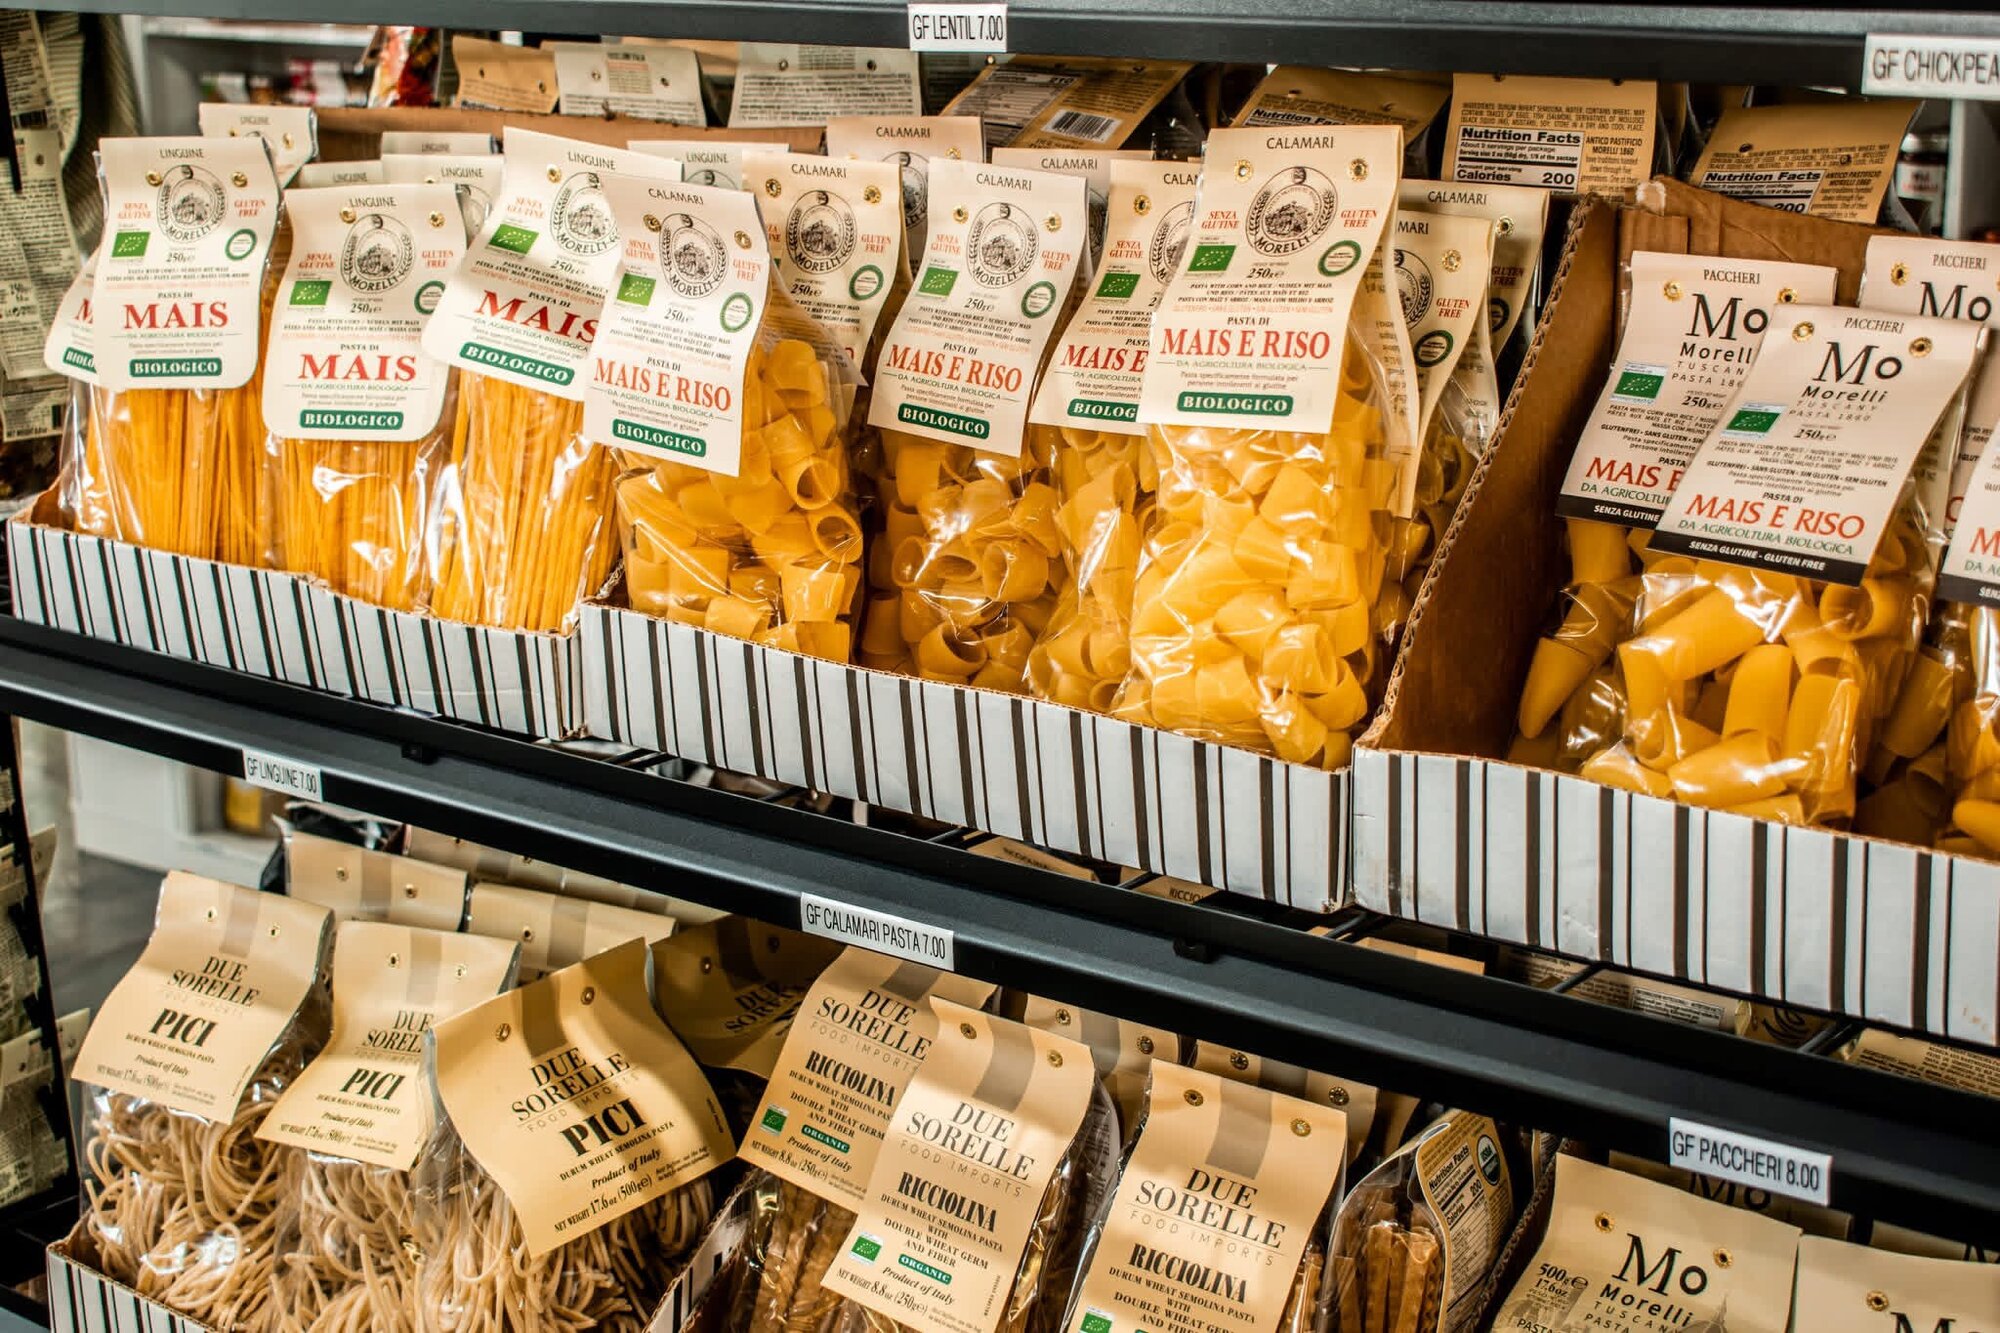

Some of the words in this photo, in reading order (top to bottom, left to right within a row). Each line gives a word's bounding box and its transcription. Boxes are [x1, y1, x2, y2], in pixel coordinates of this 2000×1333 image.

[913, 15, 929, 39] GF
[933, 15, 975, 40] LENTIL
[978, 15, 1004, 40] 7.00
[1873, 49, 1899, 80] GF
[1904, 50, 1999, 84] CHICKPEA
[876, 126, 931, 138] CALAMARI
[1266, 136, 1334, 150] CALAMARI
[1462, 127, 1531, 142] Nutrition
[1537, 131, 1581, 144] Facts
[160, 148, 204, 159] LINGUINE
[568, 152, 616, 170] LINGUINE
[1041, 157, 1098, 170] CALAMARI
[441, 167, 484, 178] LINGUINE
[791, 164, 847, 179] CALAMARI
[976, 173, 1032, 191] CALAMARI
[1457, 169, 1511, 182] Calories
[1542, 172, 1575, 185] 200
[1706, 171, 1775, 184] Nutrition
[1778, 171, 1820, 182] Facts
[350, 197, 397, 208] LINGUINE
[648, 188, 704, 205] CALAMARI
[1428, 191, 1488, 205] CALAMARI
[1202, 220, 1239, 229] GLUTINE
[1209, 211, 1238, 220] SENZA
[1340, 210, 1378, 219] GLUTEN
[1344, 219, 1369, 228] FREE
[861, 234, 892, 245] GLUTEN
[866, 244, 886, 254] FREE
[1116, 240, 1142, 250] SENZA
[1042, 250, 1071, 262] GLUTEN
[1044, 260, 1064, 271] FREE
[1110, 250, 1144, 259] GLUTINE
[1933, 254, 1986, 270] PACCHERI
[1703, 269, 1760, 285] PACCHERI
[528, 291, 554, 304] PASTA
[556, 298, 571, 308] DI
[1436, 298, 1469, 309] GLUTEN
[123, 302, 228, 330] MAIS
[474, 290, 599, 343] MAIS
[1227, 317, 1256, 326] PASTA
[1258, 317, 1270, 326] DI
[1438, 308, 1462, 318] FREE
[1684, 294, 1768, 341] Mo
[1844, 317, 1905, 334] PACCHERI
[943, 342, 967, 353] PASTA
[968, 346, 978, 355] DI
[1160, 328, 1232, 356] MAIS
[1237, 330, 1256, 356] E
[1263, 331, 1331, 359] RISO
[1679, 342, 1753, 365] Morell
[134, 360, 220, 375] BIOLOGICO
[298, 354, 417, 381] MAIS
[464, 345, 570, 383] BIOLOGICO
[646, 356, 672, 369] PASTA
[672, 362, 681, 371] DI
[886, 344, 946, 377] MAIS
[946, 356, 966, 381] E
[968, 360, 1023, 393] RISO
[1061, 345, 1131, 370] MAIS
[1812, 342, 1903, 386] Mo
[594, 358, 656, 393] MAIS
[656, 373, 670, 398] E
[675, 376, 732, 411] RISO
[1802, 386, 1888, 403] Morelli
[1073, 402, 1138, 418] BIOLOG
[1183, 396, 1288, 412] BIOLOGICO
[304, 413, 400, 427] BIOLOGICO
[902, 407, 986, 436] BIOLOGICO
[616, 423, 703, 453] BIOLOGICO
[1586, 456, 1661, 488] MAIS
[1658, 457, 1687, 467] PASTA
[1762, 492, 1791, 502] PASTA
[1594, 505, 1621, 517] SENZA
[1623, 509, 1660, 523] GLUTINE
[1684, 494, 1765, 525] MAIS
[1769, 503, 1789, 528] E
[1796, 509, 1866, 539] RISO
[1678, 519, 1697, 531] DA
[1701, 523, 1781, 544] AGRICOLTURA
[1785, 535, 1853, 555] BIOLOGICA
[1689, 542, 1716, 553] SENZA
[1718, 544, 1756, 559] GLUTINE
[1764, 553, 1799, 566] GLUTEN
[1801, 560, 1826, 571] FREE
[806, 904, 821, 925] GF
[824, 908, 880, 942] CALAMARI
[883, 924, 920, 953] PASTA
[923, 934, 946, 960] 7.00
[202, 956, 248, 983] DUE
[167, 970, 260, 1009] SORELLE
[858, 989, 917, 1027] DUE
[148, 1008, 219, 1048] PICI
[394, 1010, 434, 1033] DUE
[816, 996, 933, 1062] SORELLE
[530, 1047, 588, 1088] DUE
[805, 1050, 897, 1108] RICCIOLINA
[340, 1068, 406, 1101] PICI
[512, 1052, 632, 1122] SORELLE
[790, 1090, 825, 1114] DOUBLE
[827, 1107, 859, 1129] WHEAT
[860, 1123, 886, 1140] GERM
[830, 1099, 849, 1113] WITH
[559, 1098, 648, 1158] PICI
[808, 1111, 828, 1126] AND
[829, 1119, 855, 1139] FIBER
[952, 1102, 1015, 1143] DUE
[560, 1164, 587, 1181] DURUM
[588, 1152, 614, 1169] WHEAT
[614, 1132, 652, 1155] SEMOLINA
[651, 1121, 675, 1137] PASTA
[803, 1127, 849, 1151] ORGANIC
[906, 1112, 1037, 1182] SORELLE
[592, 1166, 627, 1190] Product
[628, 1158, 639, 1174] of
[638, 1148, 662, 1169] Italy
[901, 1140, 943, 1167] FOOD
[951, 1161, 1023, 1198] IMPORTS
[1673, 1131, 1695, 1157] GF
[1700, 1138, 1781, 1181] PACCHERI
[1786, 1160, 1820, 1192] 8.00
[1187, 1167, 1259, 1211] DUE
[590, 1198, 609, 1216] 17.6
[898, 1171, 997, 1234] RICCIOLINA
[1135, 1180, 1287, 1250] SORELLE
[1130, 1210, 1180, 1235] FOOD
[1191, 1230, 1274, 1267] IMPORTS
[900, 1255, 951, 1284] ORGANIC
[1128, 1242, 1247, 1305] RICCIOLINA
[1612, 1232, 1708, 1297] Mo
[882, 1266, 917, 1290] Product
[918, 1281, 932, 1297] of
[931, 1284, 955, 1306] Italy
[1109, 1266, 1142, 1285] DURUM
[1145, 1279, 1178, 1300] WHEAT
[1178, 1290, 1226, 1314] SEMOLINA
[1227, 1308, 1256, 1324] PASTA
[1114, 1292, 1159, 1316] DOUBLE
[1165, 1308, 1205, 1328] WHEAT
[1167, 1297, 1192, 1314] WITH
[1600, 1283, 1695, 1328] Morelli
